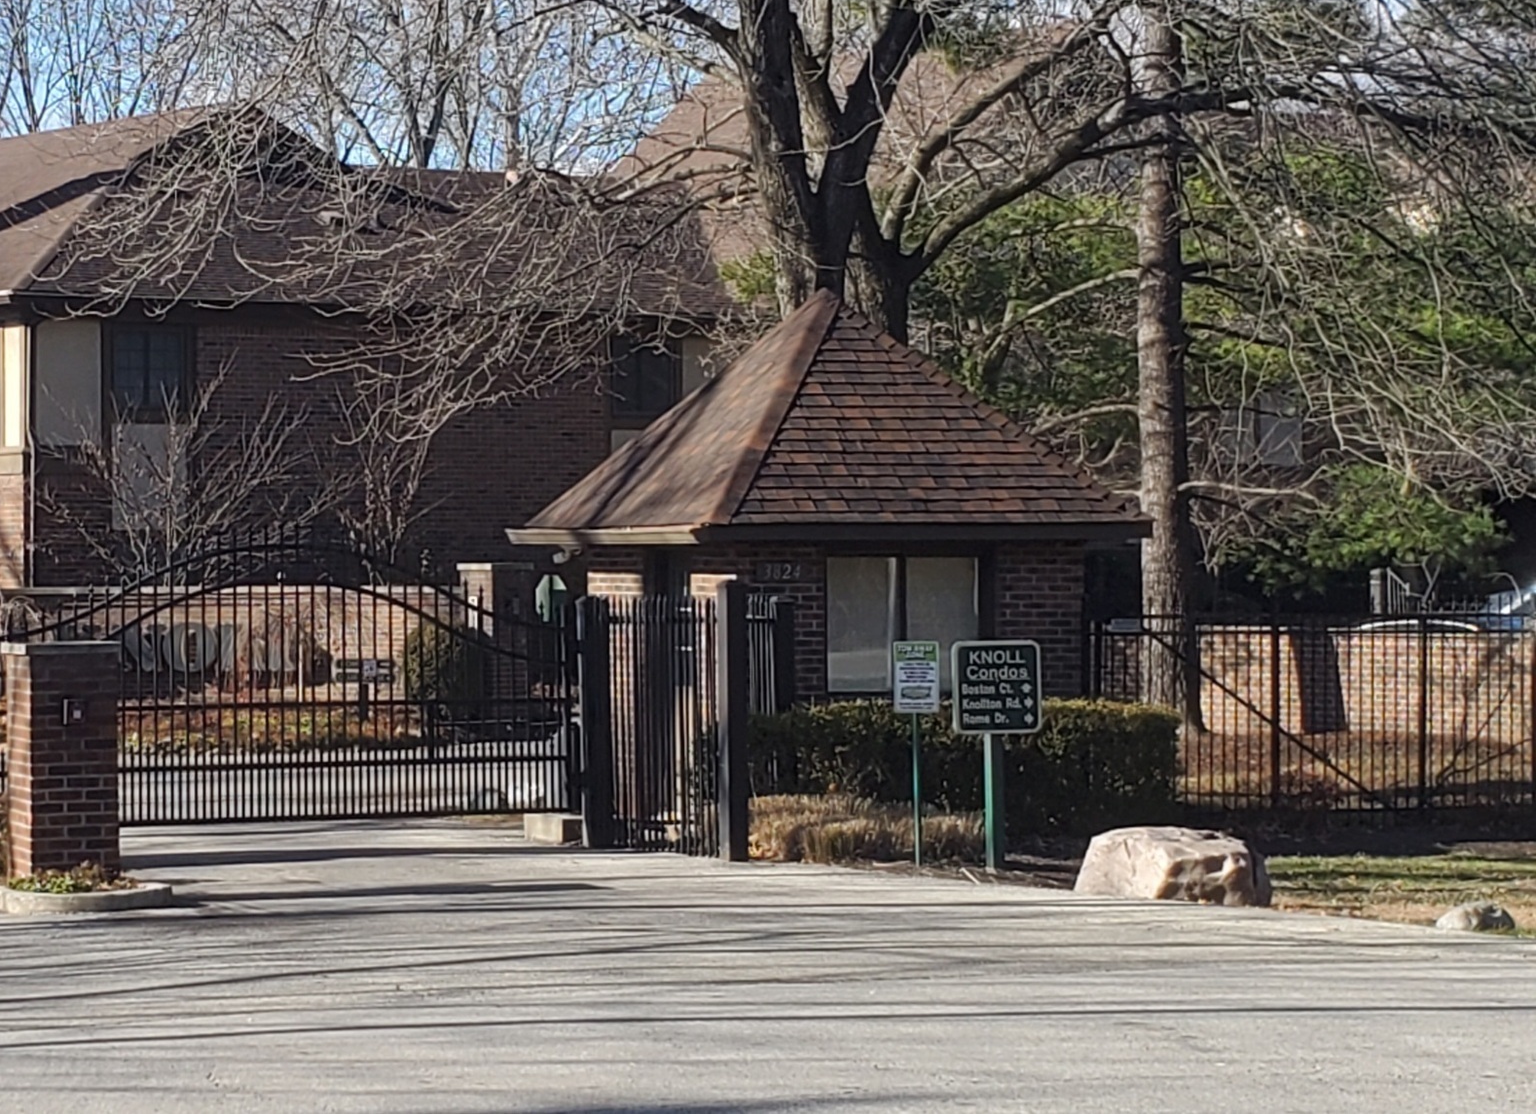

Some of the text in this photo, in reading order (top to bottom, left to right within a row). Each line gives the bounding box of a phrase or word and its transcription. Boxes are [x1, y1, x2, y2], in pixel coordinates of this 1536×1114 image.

[764, 563, 801, 580] 3824
[969, 649, 1026, 664] KNOLL
[966, 665, 1028, 680] Condos
[962, 682, 1014, 695] Boston Ct.
[962, 697, 1022, 710] Knollton Rd.
[994, 711, 1010, 724] Dr.
